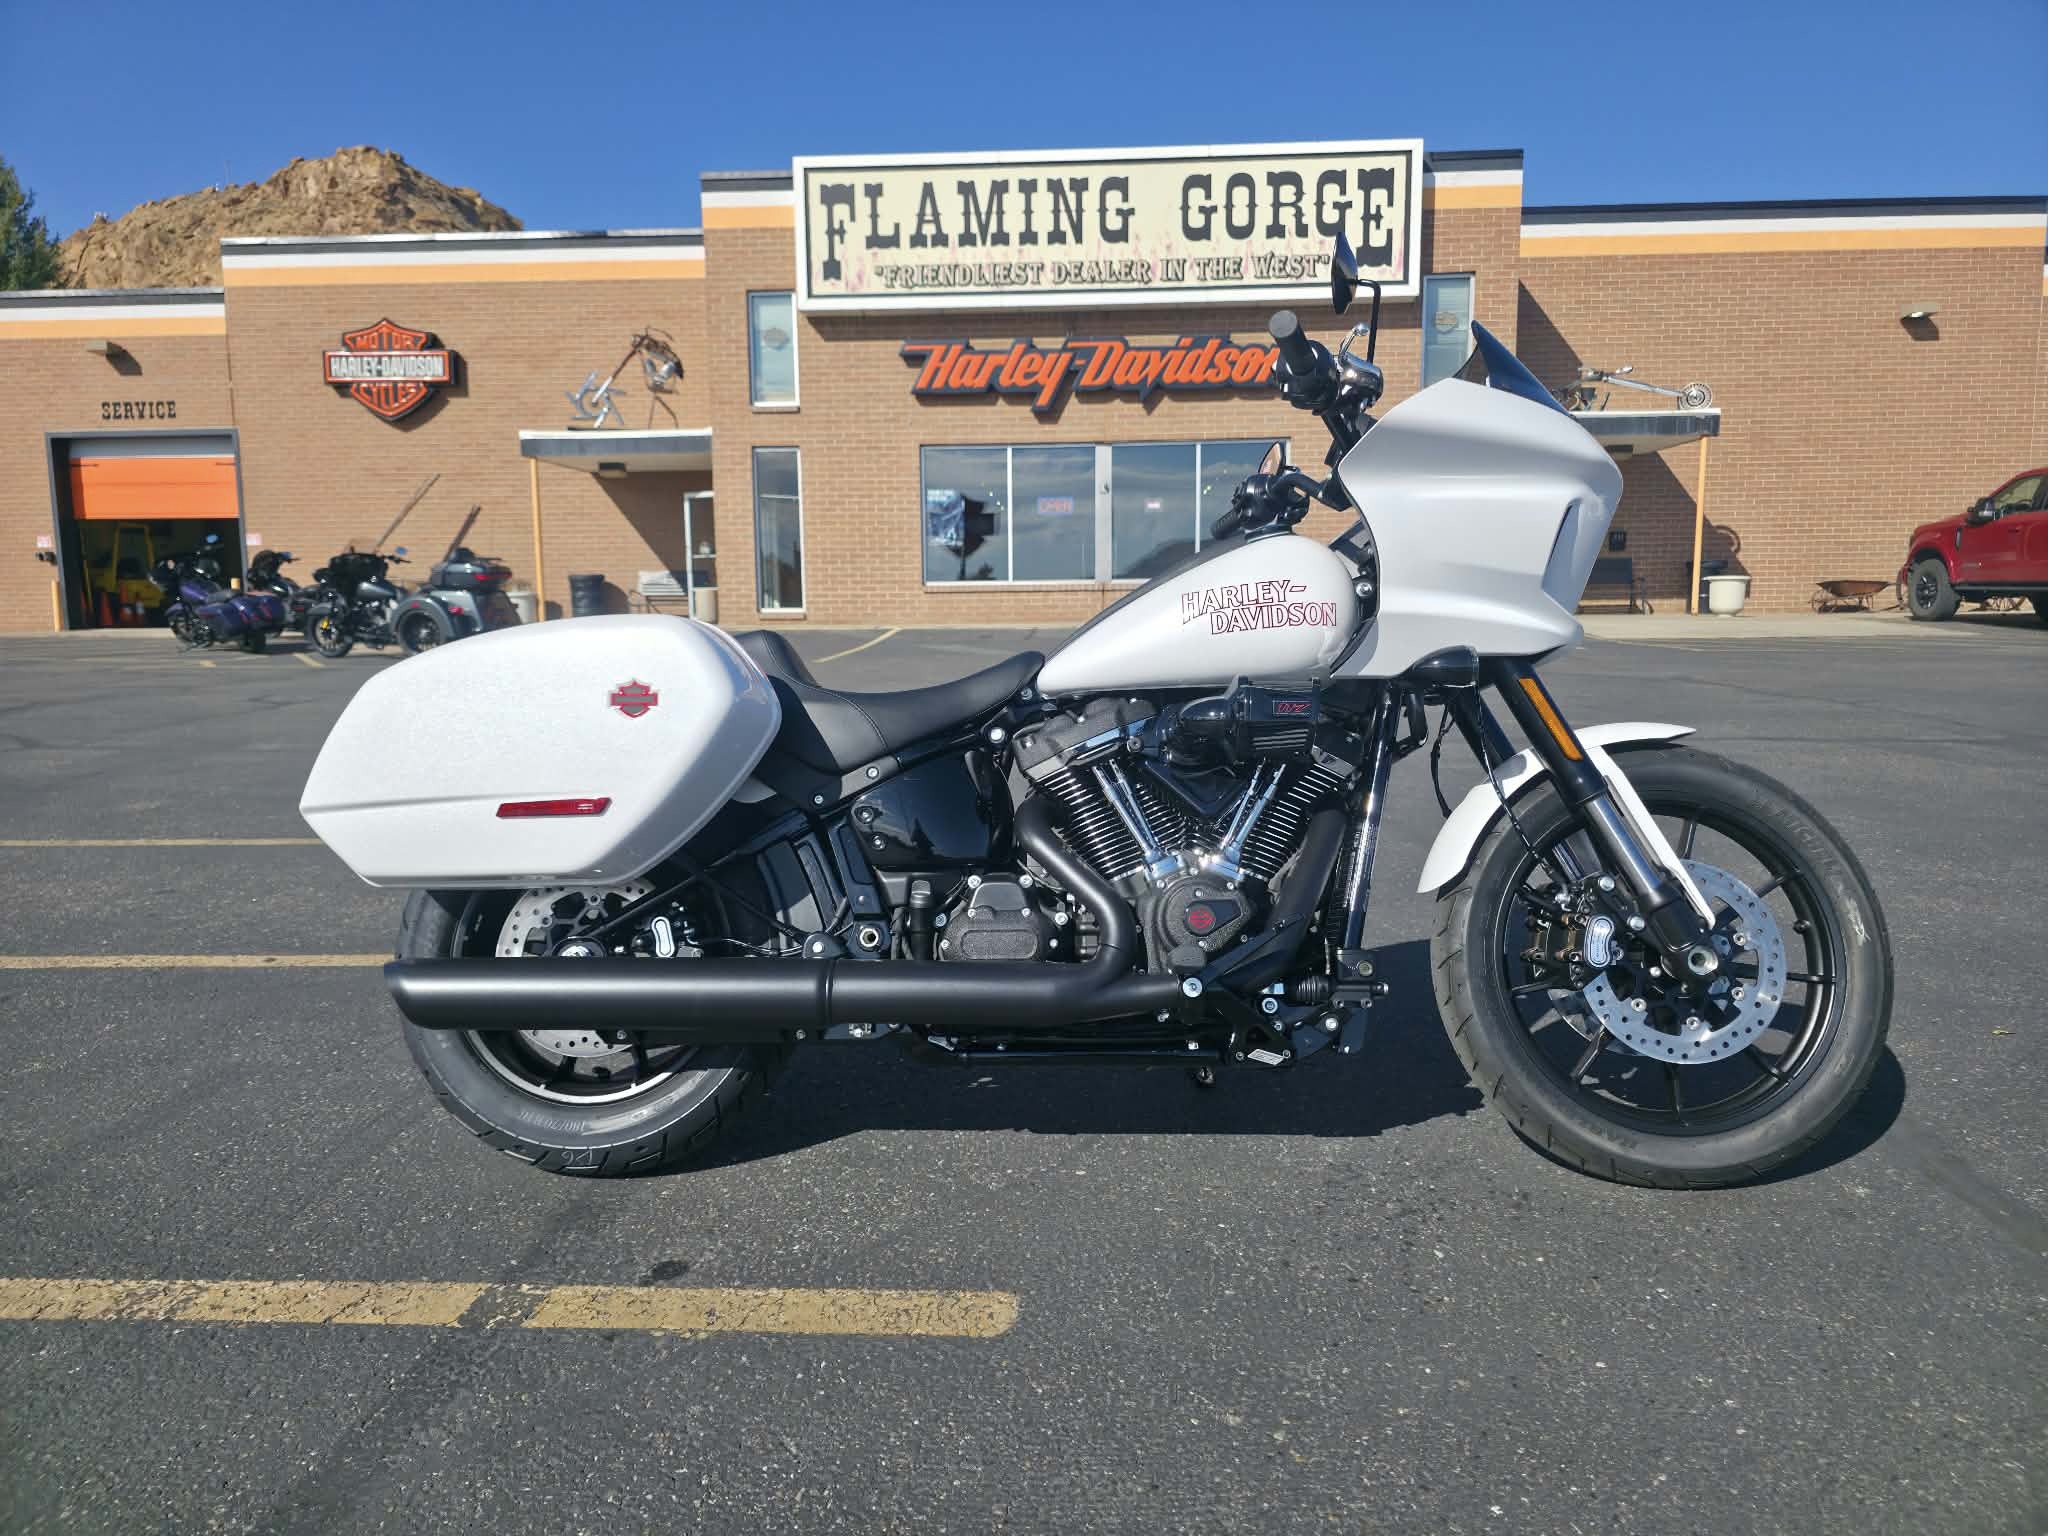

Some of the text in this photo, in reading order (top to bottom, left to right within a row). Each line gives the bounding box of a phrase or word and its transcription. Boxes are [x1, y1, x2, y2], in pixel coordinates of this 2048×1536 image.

[820, 167, 1395, 280] FLAMING GORGE
[874, 251, 1330, 288] "FRIENDLIEST DEALER IN THE WEST"
[330, 356, 444, 377] HARLEY-DAVIDSON
[101, 401, 177, 420] SERVICE
[1182, 580, 1307, 624] HARLEY-
[1211, 602, 1336, 635] DAVIDSON
